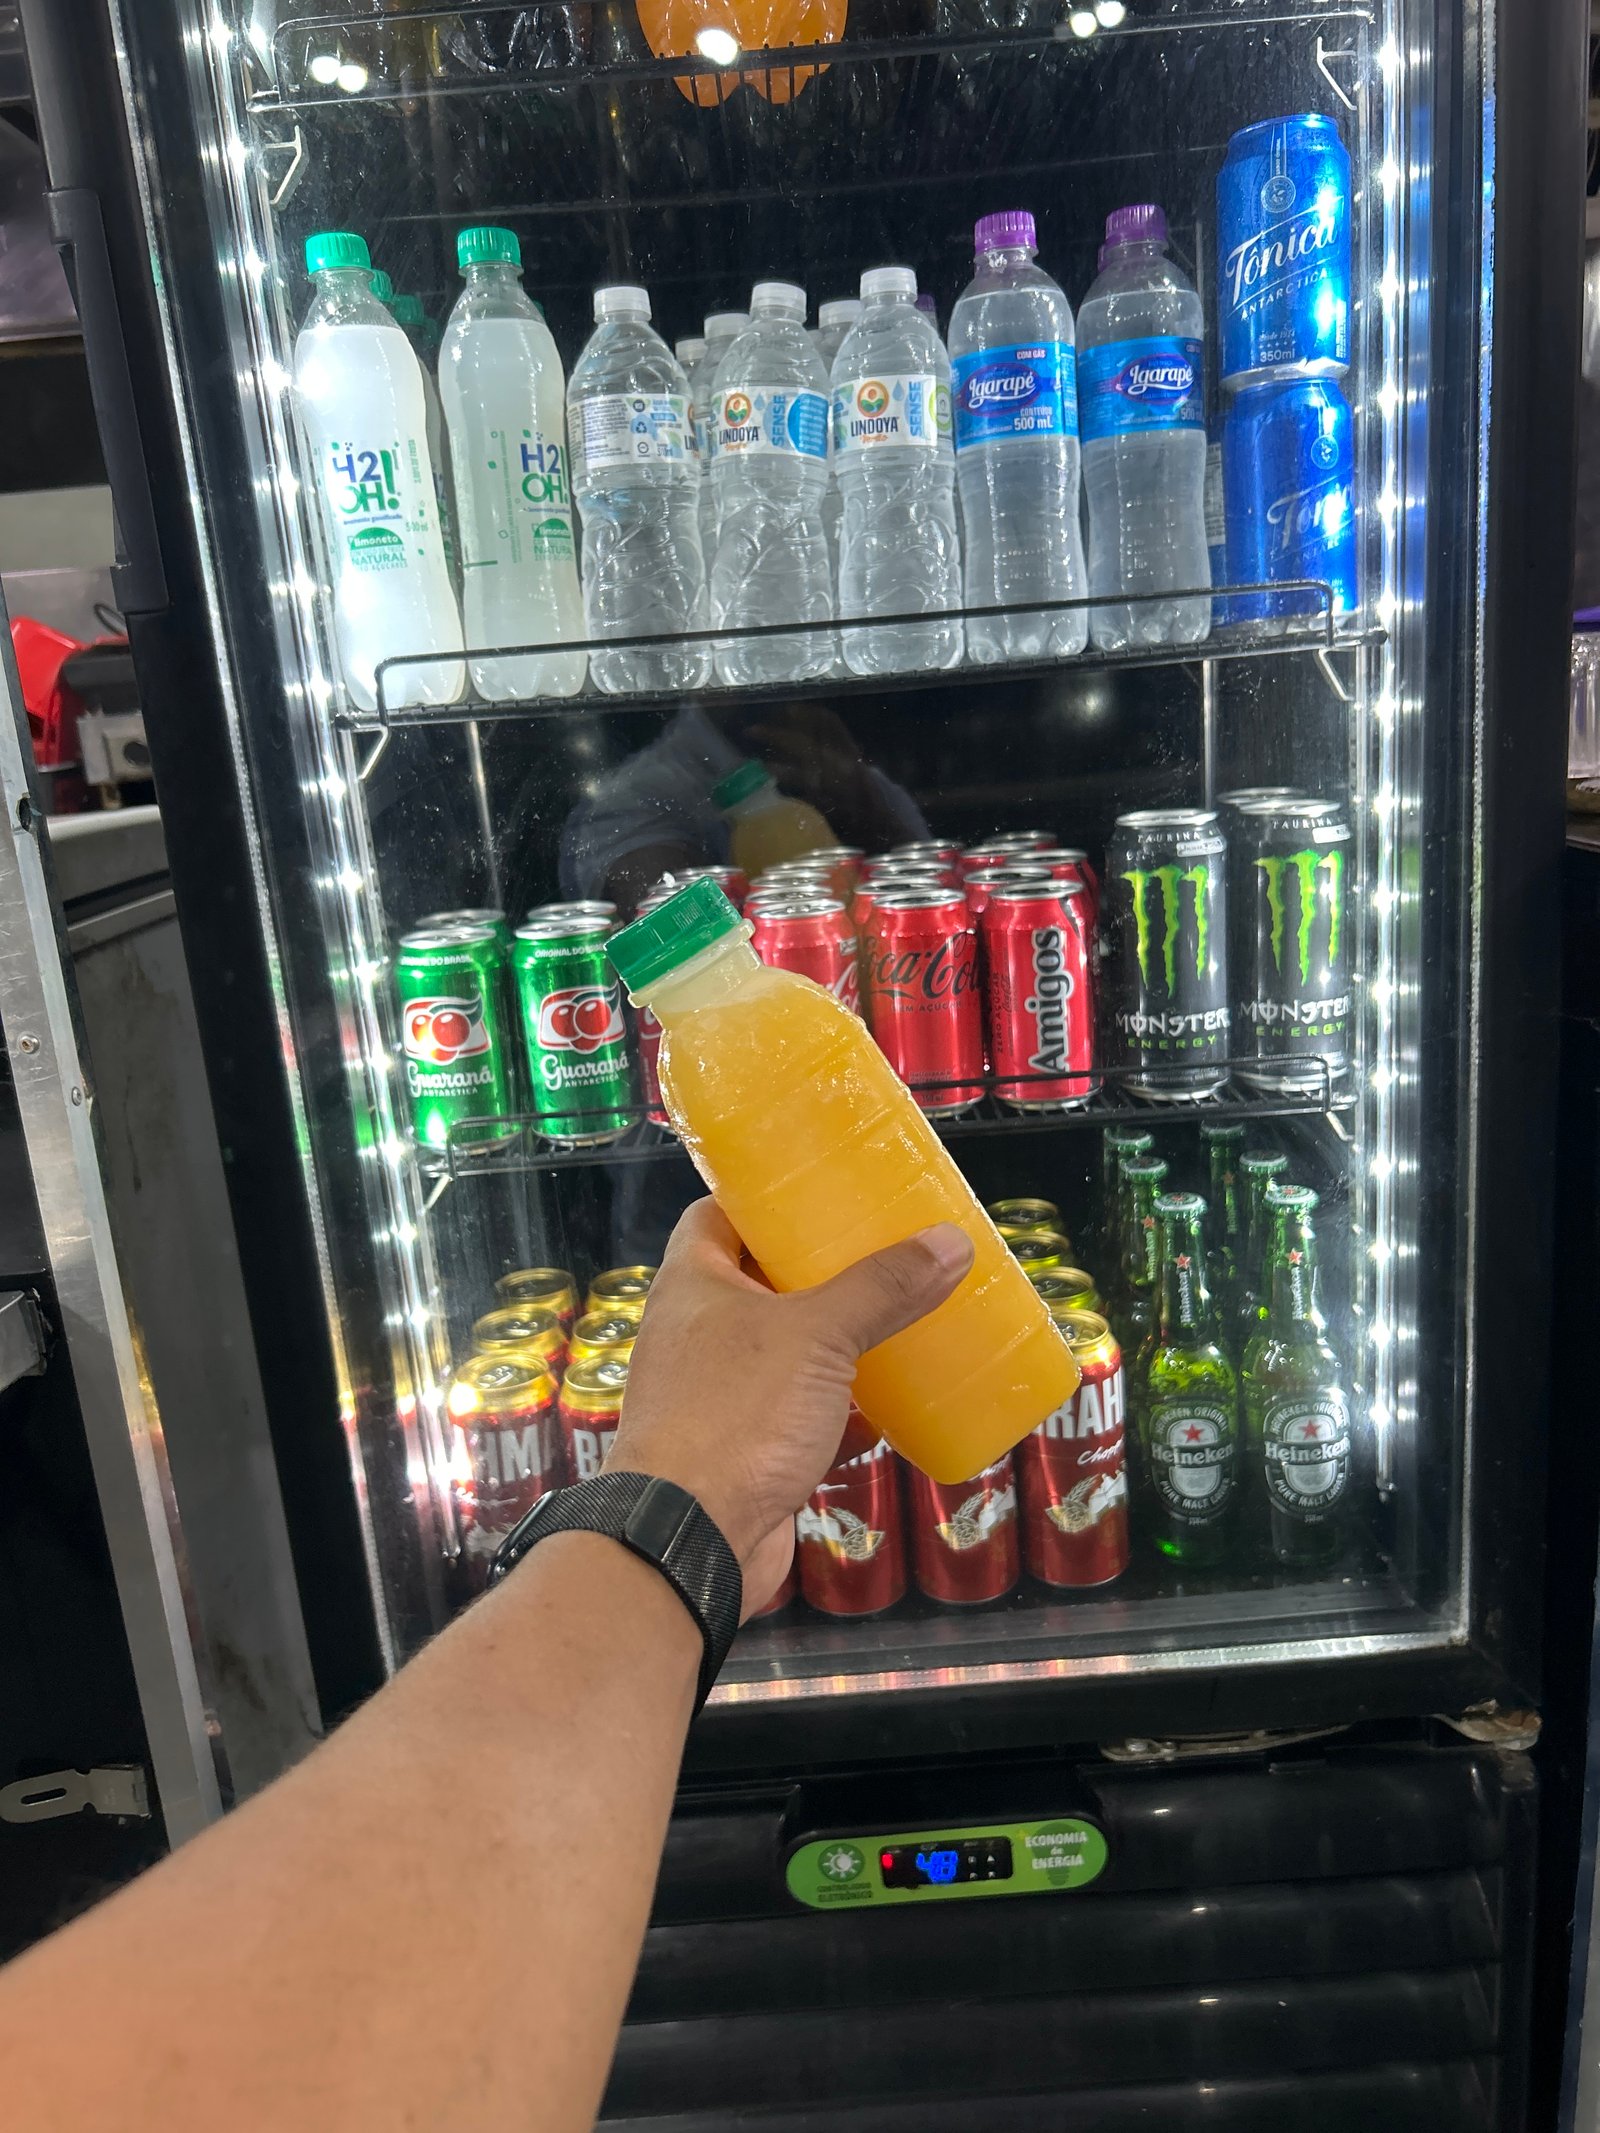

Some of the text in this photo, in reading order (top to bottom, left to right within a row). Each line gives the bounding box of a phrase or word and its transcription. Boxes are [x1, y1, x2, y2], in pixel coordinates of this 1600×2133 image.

[1225, 198, 1343, 306] Tônica
[1240, 267, 1328, 320] ANTARCTICA
[968, 371, 1037, 409] Igarapé
[1127, 364, 1195, 396] Igarapé
[772, 394, 786, 446] SENSE
[908, 381, 923, 436] SENSE
[719, 425, 759, 445] LINDOYA
[850, 416, 899, 438] LINDOYA
[1014, 417, 1035, 431] 500
[351, 551, 407, 566] NATURAL
[1272, 817, 1333, 830] TAURINA
[1137, 830, 1201, 844] TAURINA
[1026, 927, 1073, 1074] Amigos
[1115, 1006, 1231, 1037] MONSTER
[1255, 1021, 1345, 1037] ENERGY
[1127, 1034, 1217, 1050] ENERGY
[407, 1060, 495, 1098] Guaraná
[540, 1051, 631, 1091] Guaraná
[564, 1074, 620, 1088] ANTARCTICA
[422, 1086, 479, 1097] ANTARCTICA
[1156, 1406, 1228, 1434] HEINEKEN ORIGINAL
[1271, 1403, 1308, 1434] HEINEKEN
[1151, 1441, 1234, 1466] Heineken
[1264, 1434, 1350, 1463] Heineken
[1181, 1497, 1210, 1510] MALT
[1275, 1479, 1297, 1503] PURE
[1298, 1494, 1325, 1507] MALT
[1025, 1831, 1088, 1847] ECONOMIA
[1032, 1854, 1085, 1870] ENERGIA
